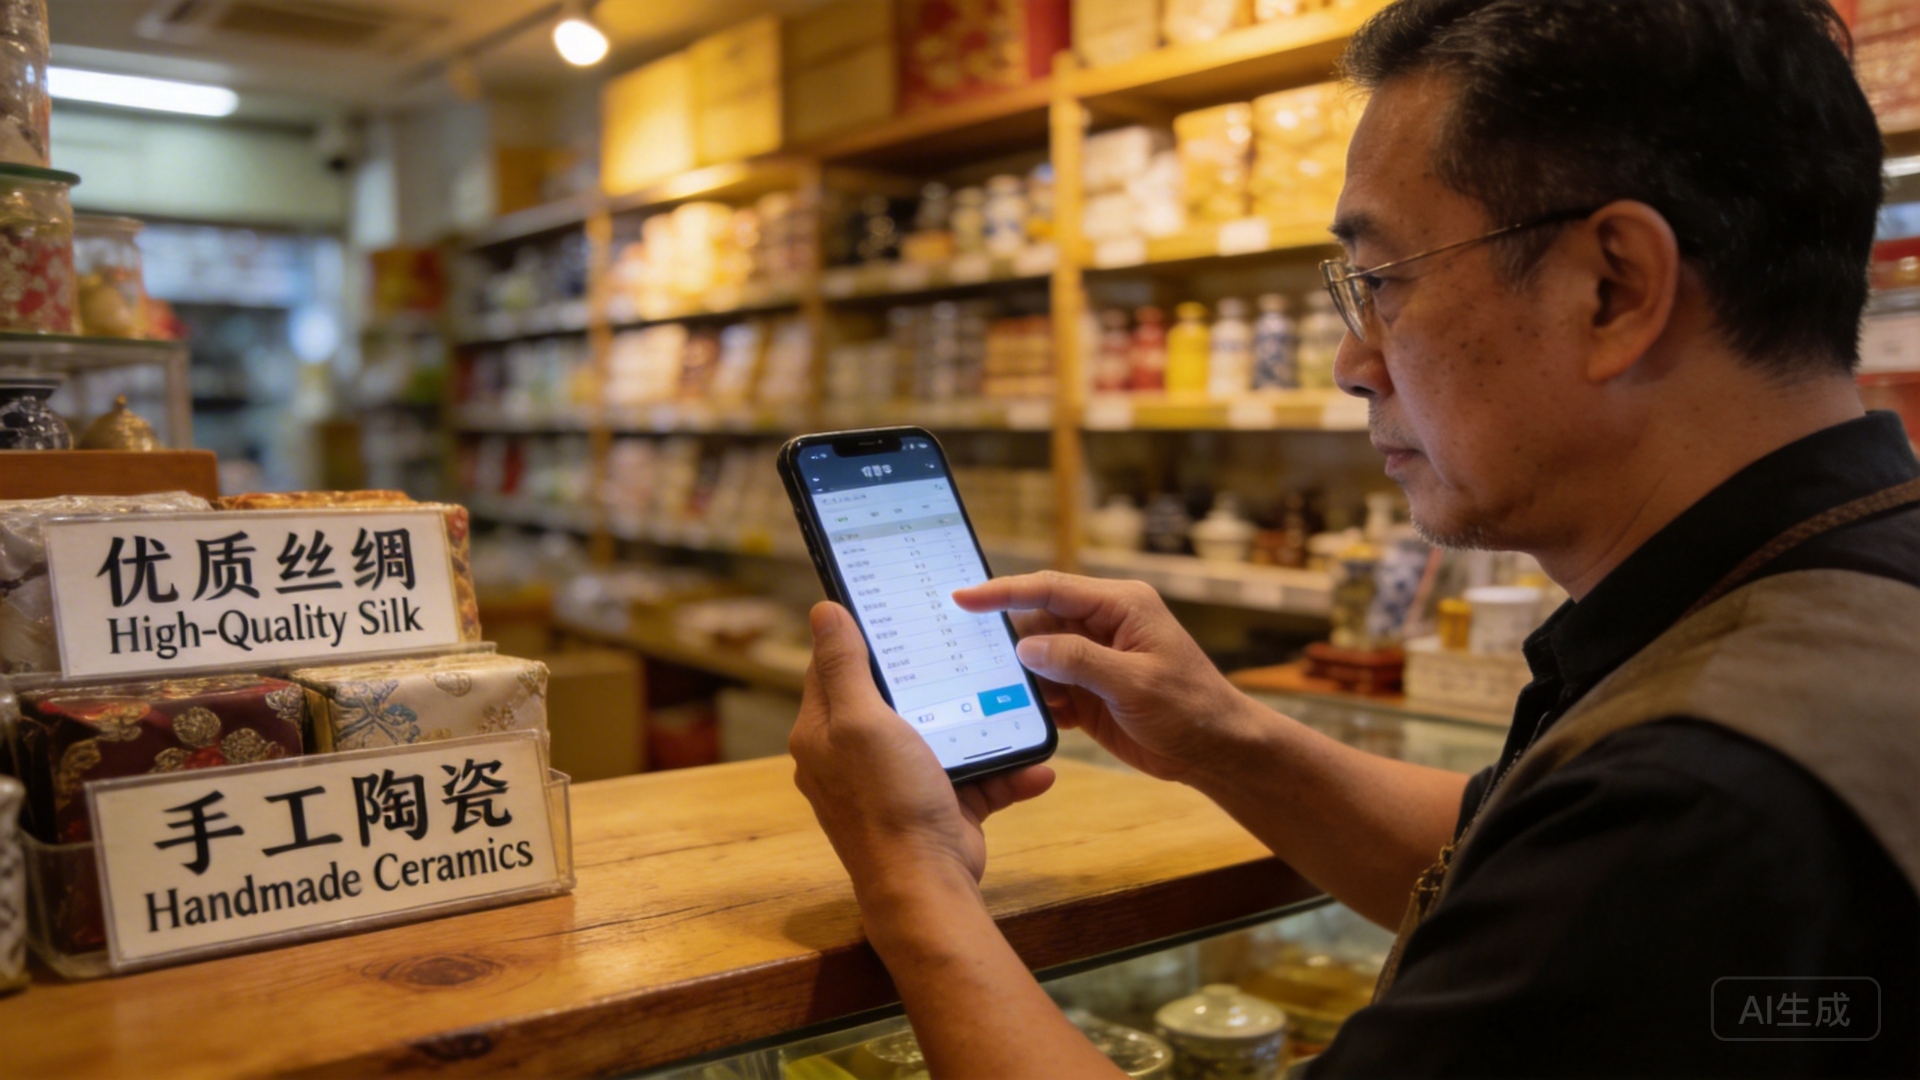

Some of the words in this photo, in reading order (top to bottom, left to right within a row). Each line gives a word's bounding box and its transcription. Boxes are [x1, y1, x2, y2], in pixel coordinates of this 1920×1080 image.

[96, 528, 416, 608] 优质丝绸
[107, 603, 346, 660] High-Quality
[358, 597, 424, 636] Silk
[153, 758, 513, 876] 手工陶瓷
[144, 861, 362, 933] Handmade
[373, 837, 534, 892] Ceramics
